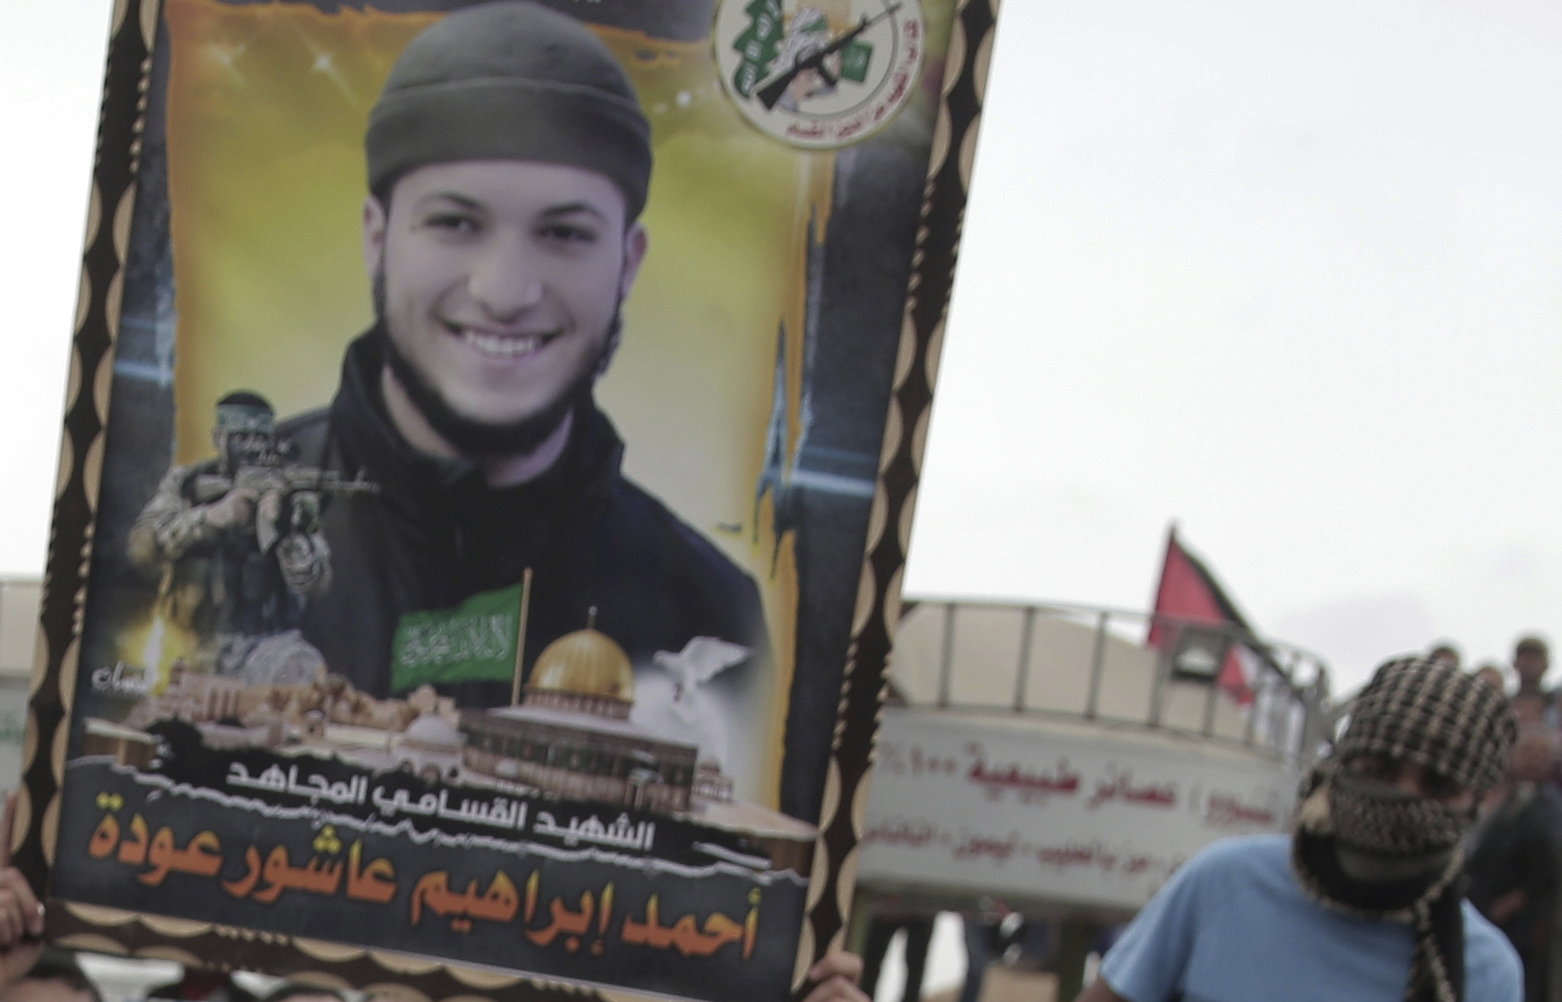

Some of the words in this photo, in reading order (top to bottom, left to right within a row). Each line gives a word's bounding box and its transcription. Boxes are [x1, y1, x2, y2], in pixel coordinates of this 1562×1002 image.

[226, 761, 368, 806] المجاهد
[372, 784, 528, 831] القسامي
[89, 791, 223, 887] عودة
[222, 823, 397, 904] عاشور
[533, 809, 655, 852] الشهيد
[410, 868, 615, 955] إبراهيم
[622, 886, 762, 960] أحمد
